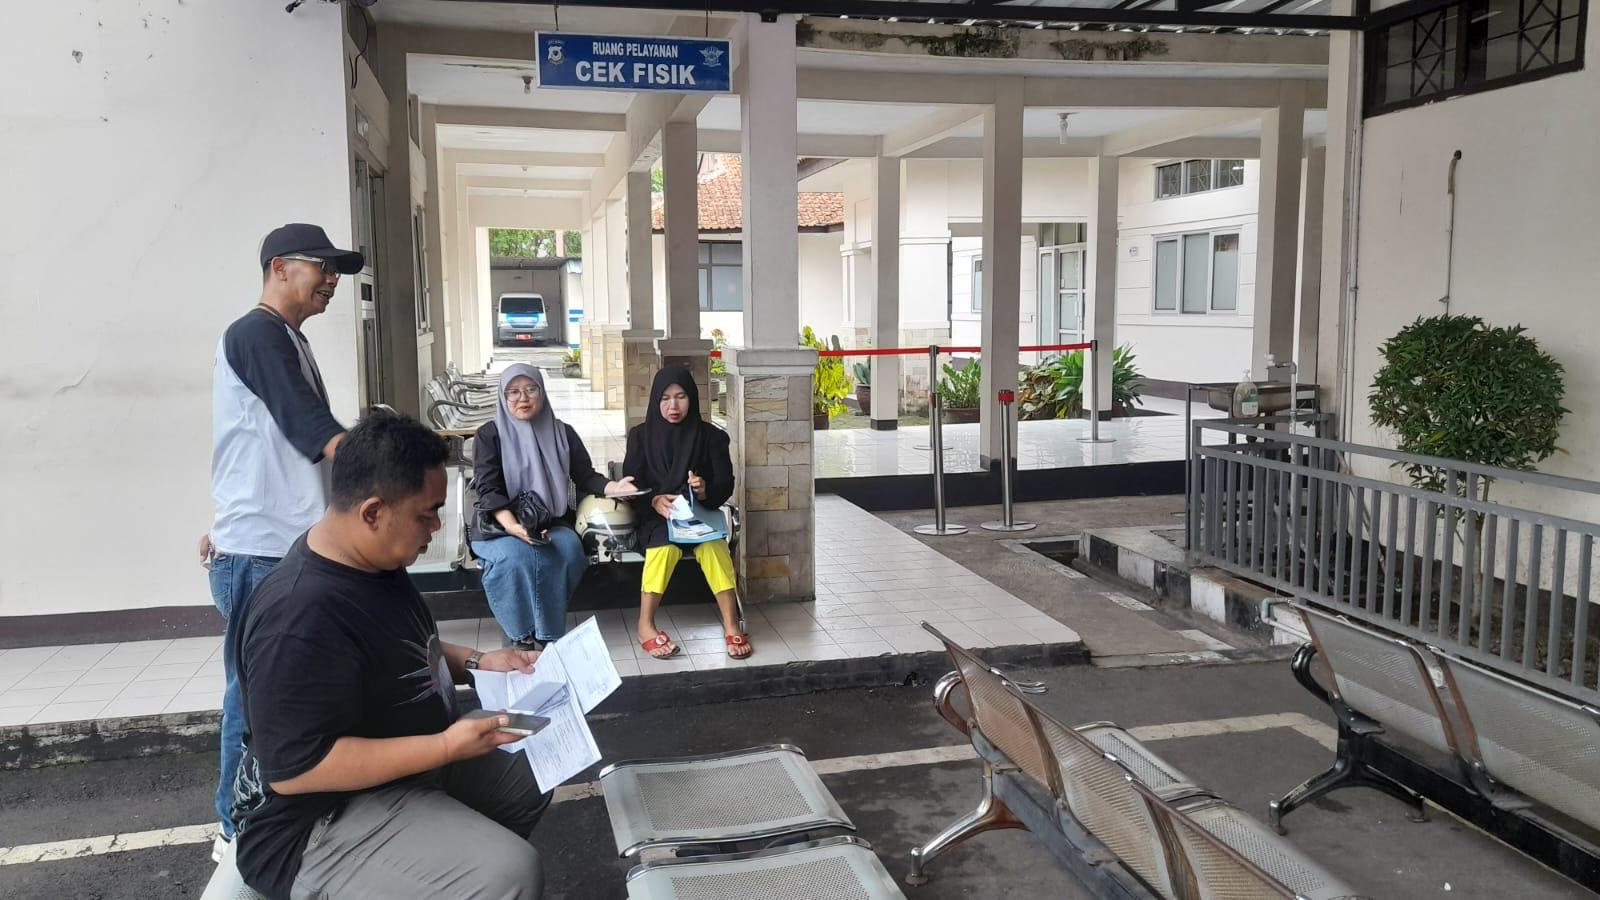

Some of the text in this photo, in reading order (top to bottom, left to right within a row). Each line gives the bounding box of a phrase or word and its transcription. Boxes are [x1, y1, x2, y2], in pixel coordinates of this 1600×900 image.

[592, 41, 678, 58] RUANG PELAYANAN
[575, 60, 696, 85] CEK FISIK
